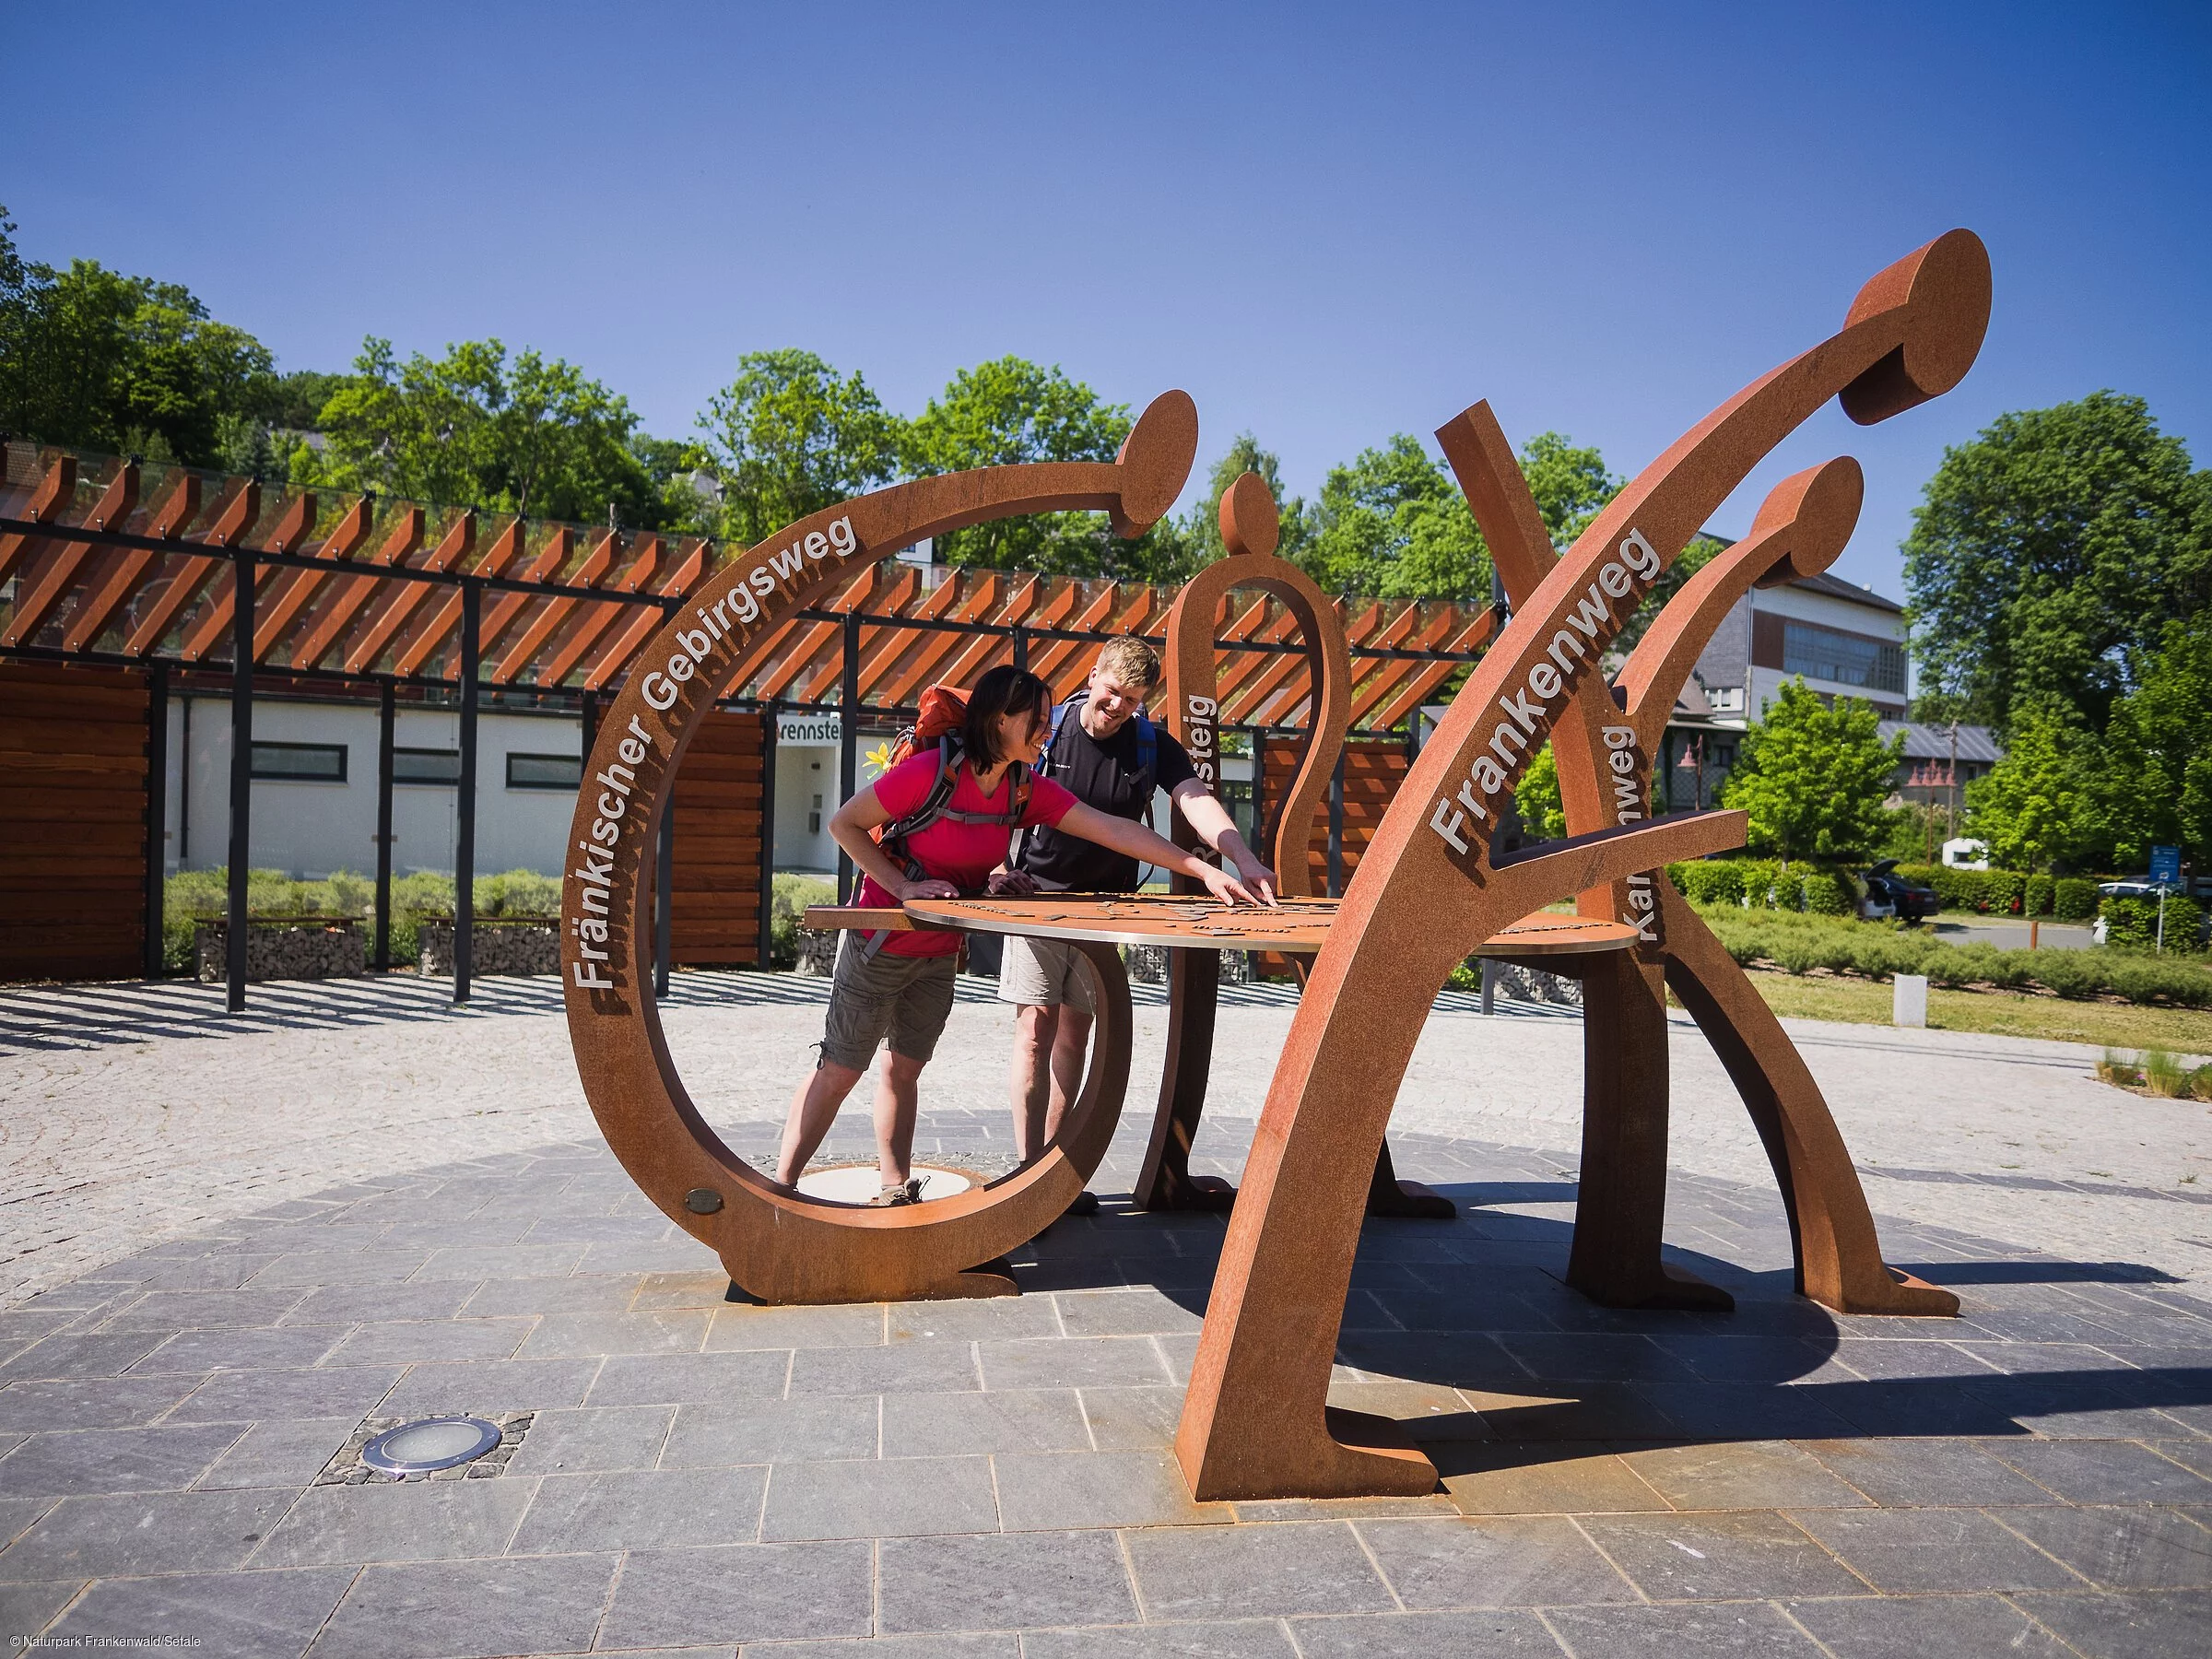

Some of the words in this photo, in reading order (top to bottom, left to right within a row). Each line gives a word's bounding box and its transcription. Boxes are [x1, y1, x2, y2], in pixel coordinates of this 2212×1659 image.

[573, 713, 652, 989] Fränkischer
[641, 516, 857, 712] Gebirgsweg
[1430, 527, 1661, 854] Frankenweg
